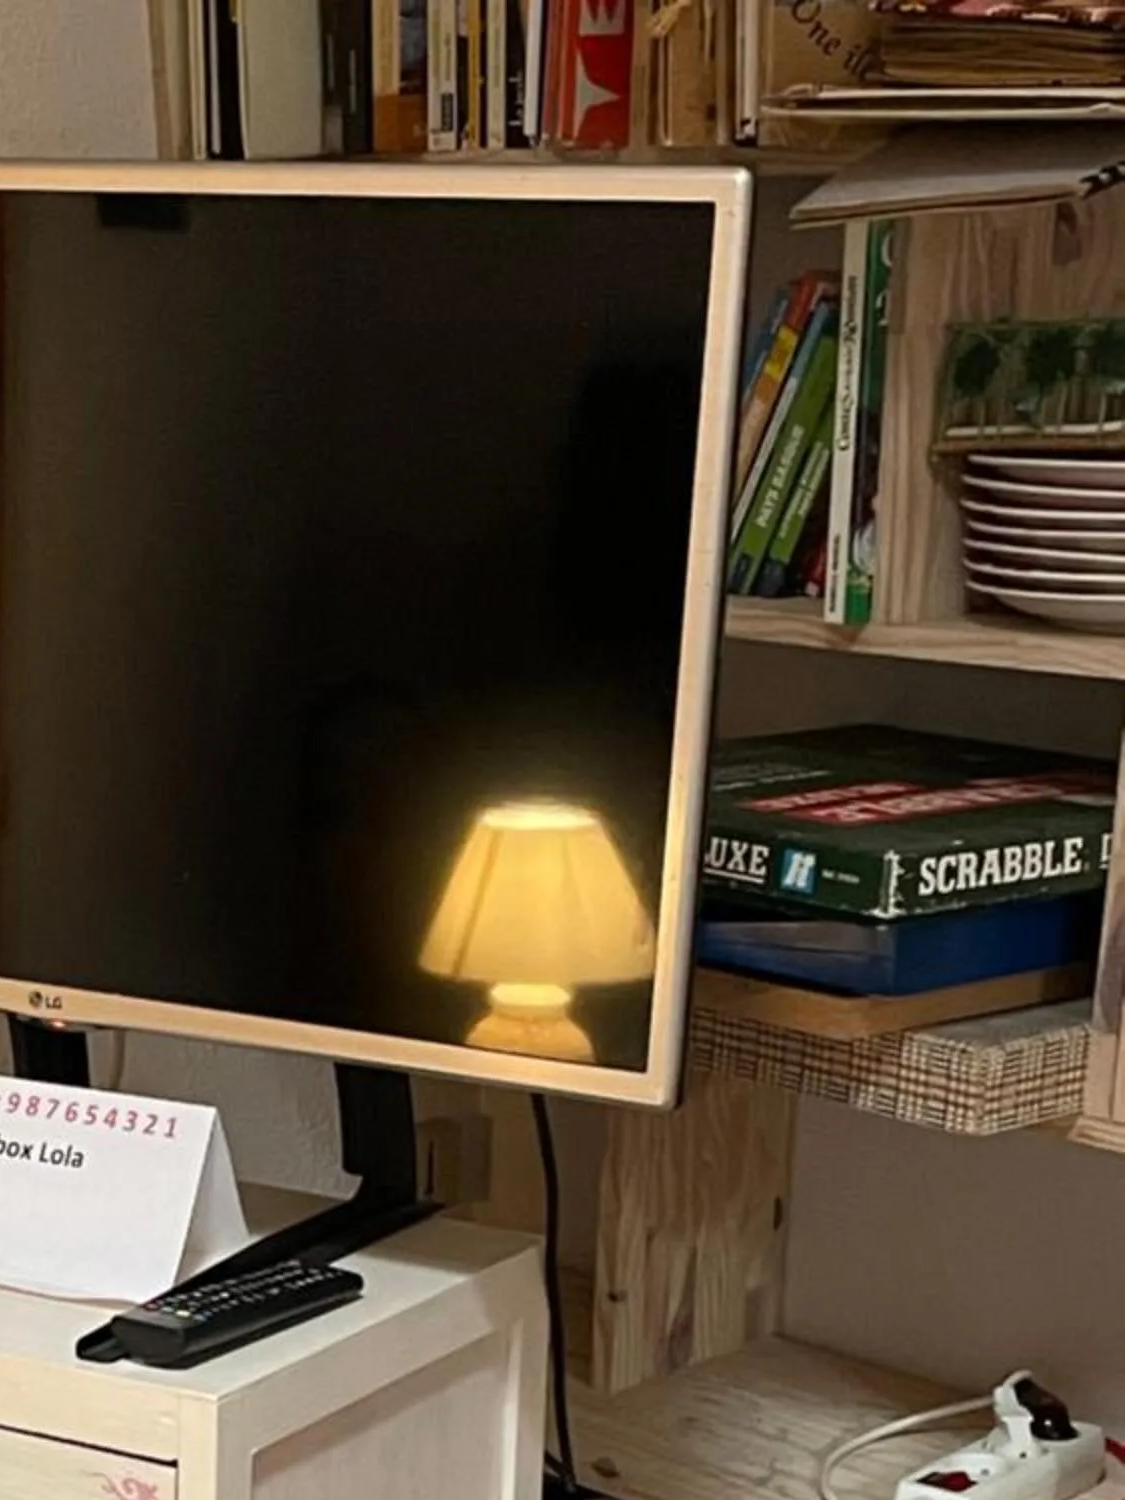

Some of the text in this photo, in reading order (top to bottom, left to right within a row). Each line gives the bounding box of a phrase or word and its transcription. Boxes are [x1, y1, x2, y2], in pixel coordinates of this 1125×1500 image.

[704, 836, 770, 876] UXE
[918, 836, 1084, 896] SCRABBLE
[38, 1142, 85, 1169] Lola
